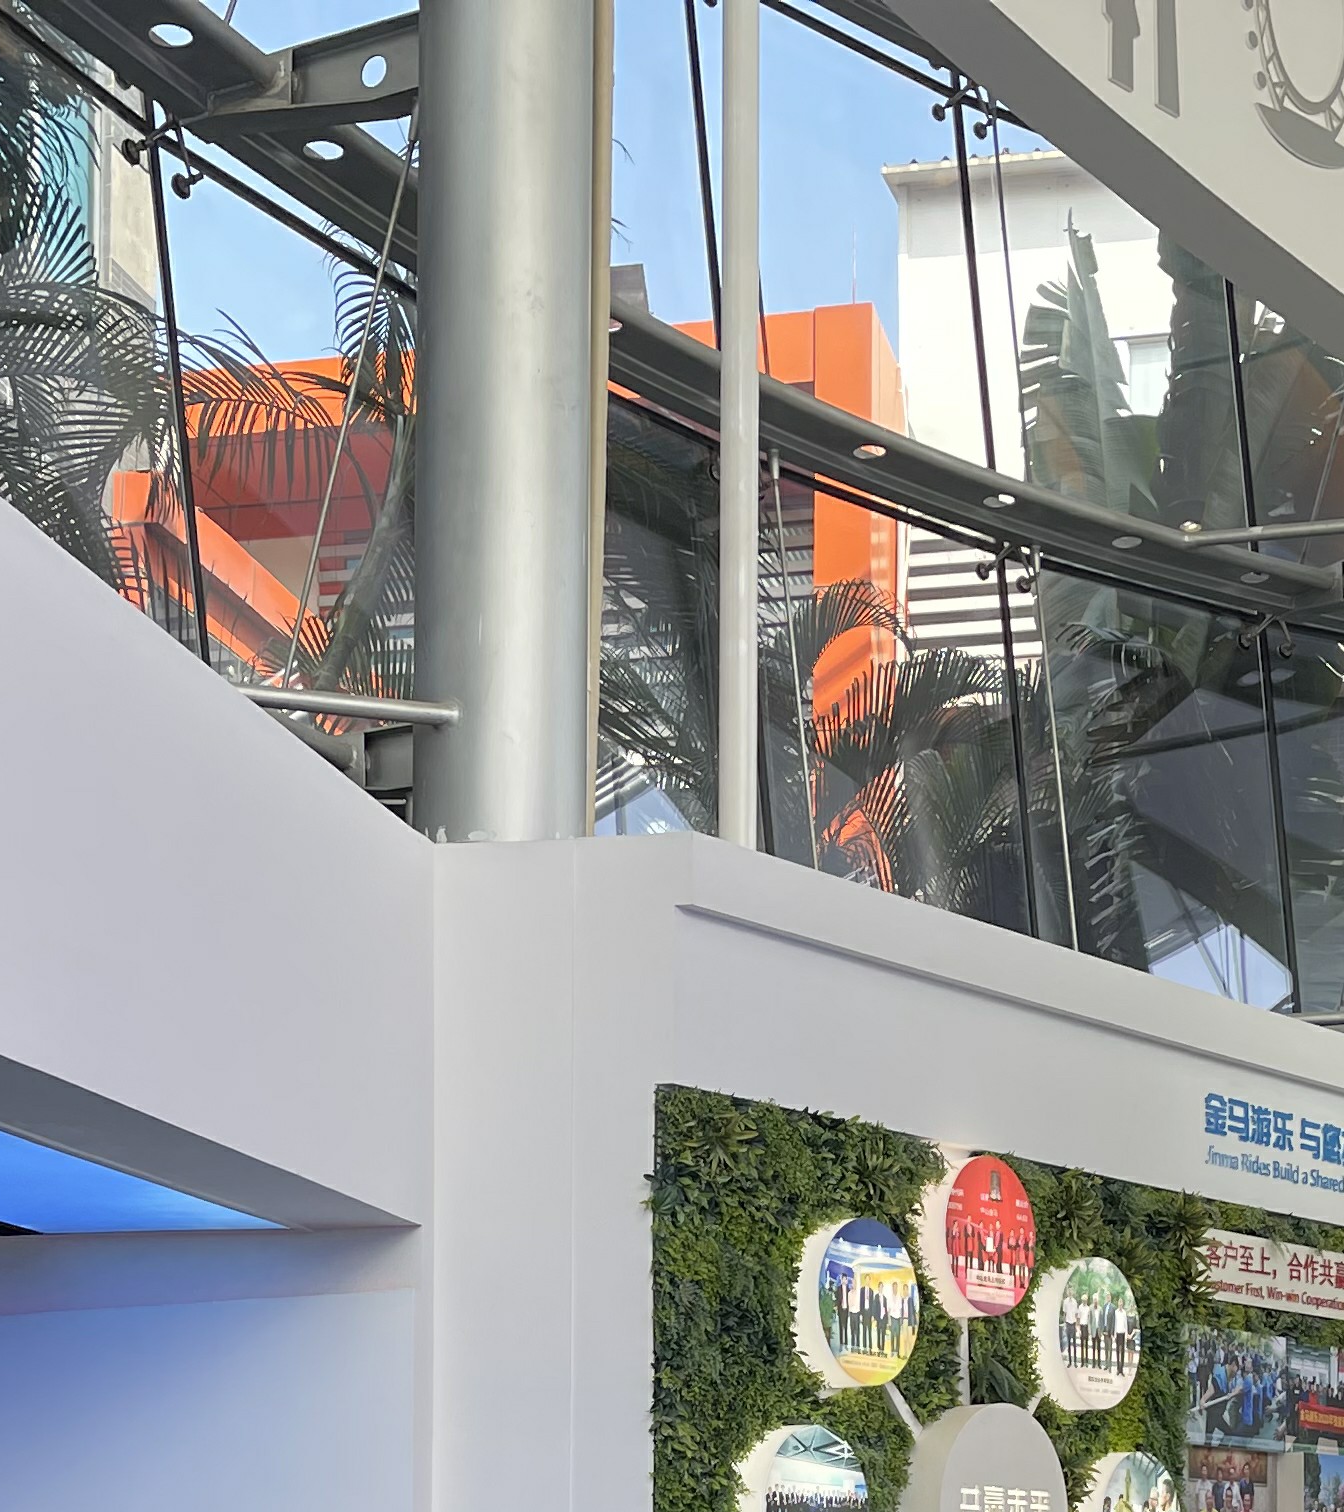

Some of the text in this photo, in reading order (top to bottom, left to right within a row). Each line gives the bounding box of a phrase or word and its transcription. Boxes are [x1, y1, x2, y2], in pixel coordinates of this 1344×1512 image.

[1205, 1093, 1293, 1151] 金马游乐
[1205, 1145, 1238, 1171] Jinma
[1241, 1151, 1270, 1177] Rides
[1273, 1160, 1298, 1184] Build
[1302, 1172, 1308, 1185] a
[1310, 1169, 1344, 1194] Shared
